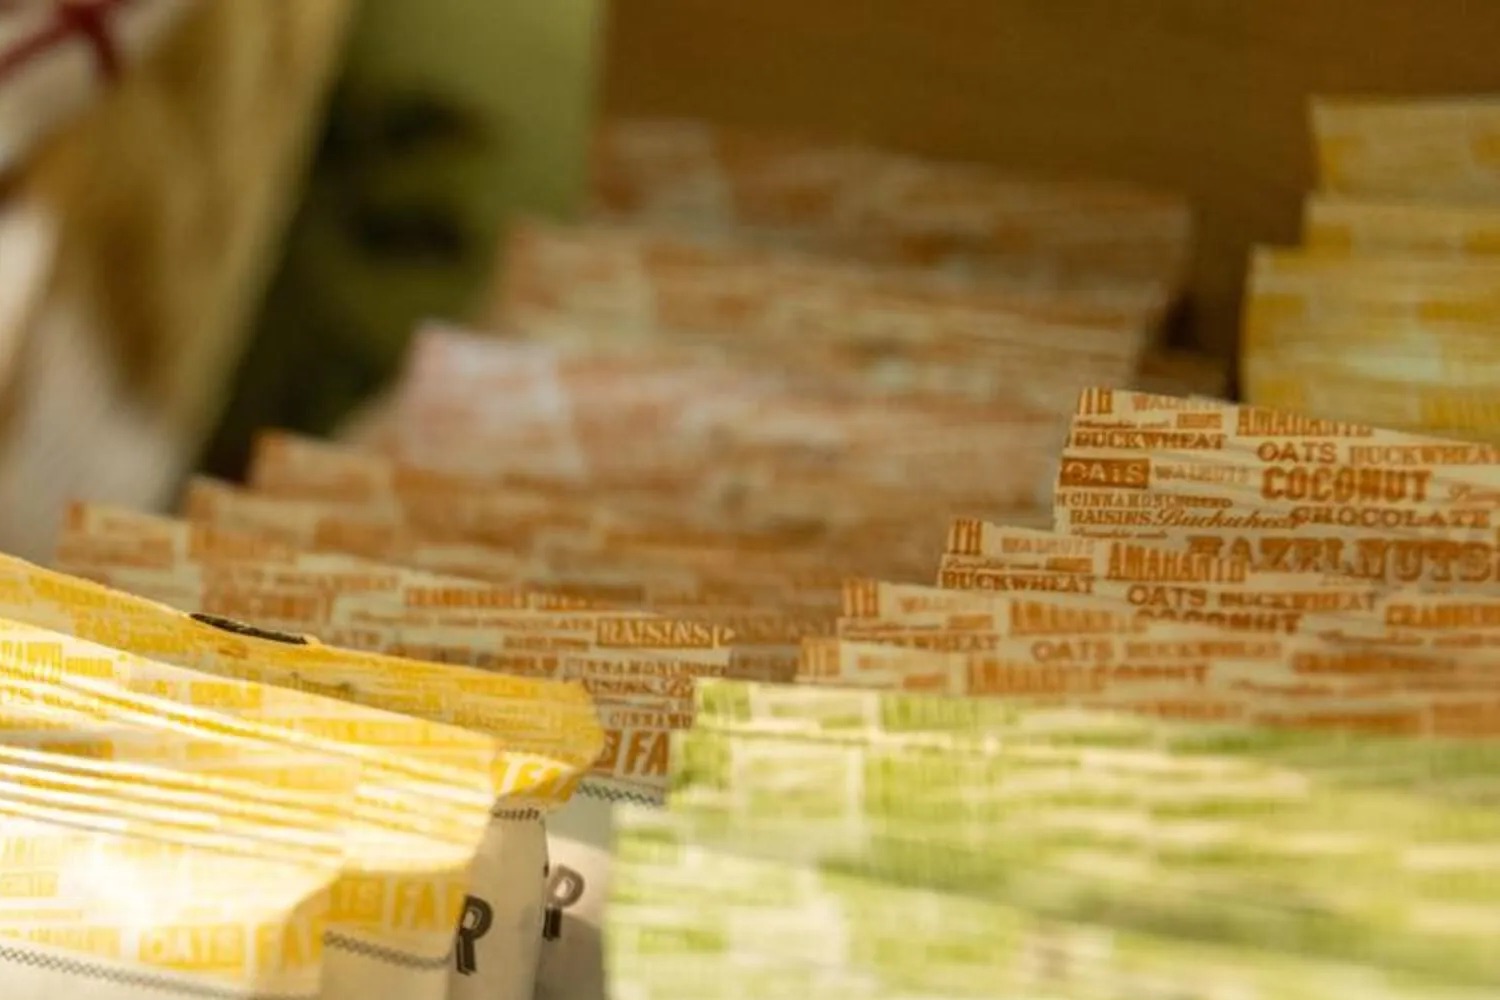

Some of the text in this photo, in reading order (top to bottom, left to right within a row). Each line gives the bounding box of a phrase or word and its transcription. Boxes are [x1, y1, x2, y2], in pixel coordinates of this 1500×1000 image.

[1073, 431, 1226, 450] BUCKWHEAT
[1257, 441, 1337, 464] OATS
[1261, 467, 1432, 503] COCONUT
[1070, 510, 1152, 525] RAISINS
[1290, 506, 1490, 529] CHOCOLATE
[1186, 535, 1493, 583] HAZELNUTS
[941, 570, 1096, 594] BUCKWHEAT
[1127, 584, 1207, 608] OATS
[600, 620, 711, 645] RAISINS
